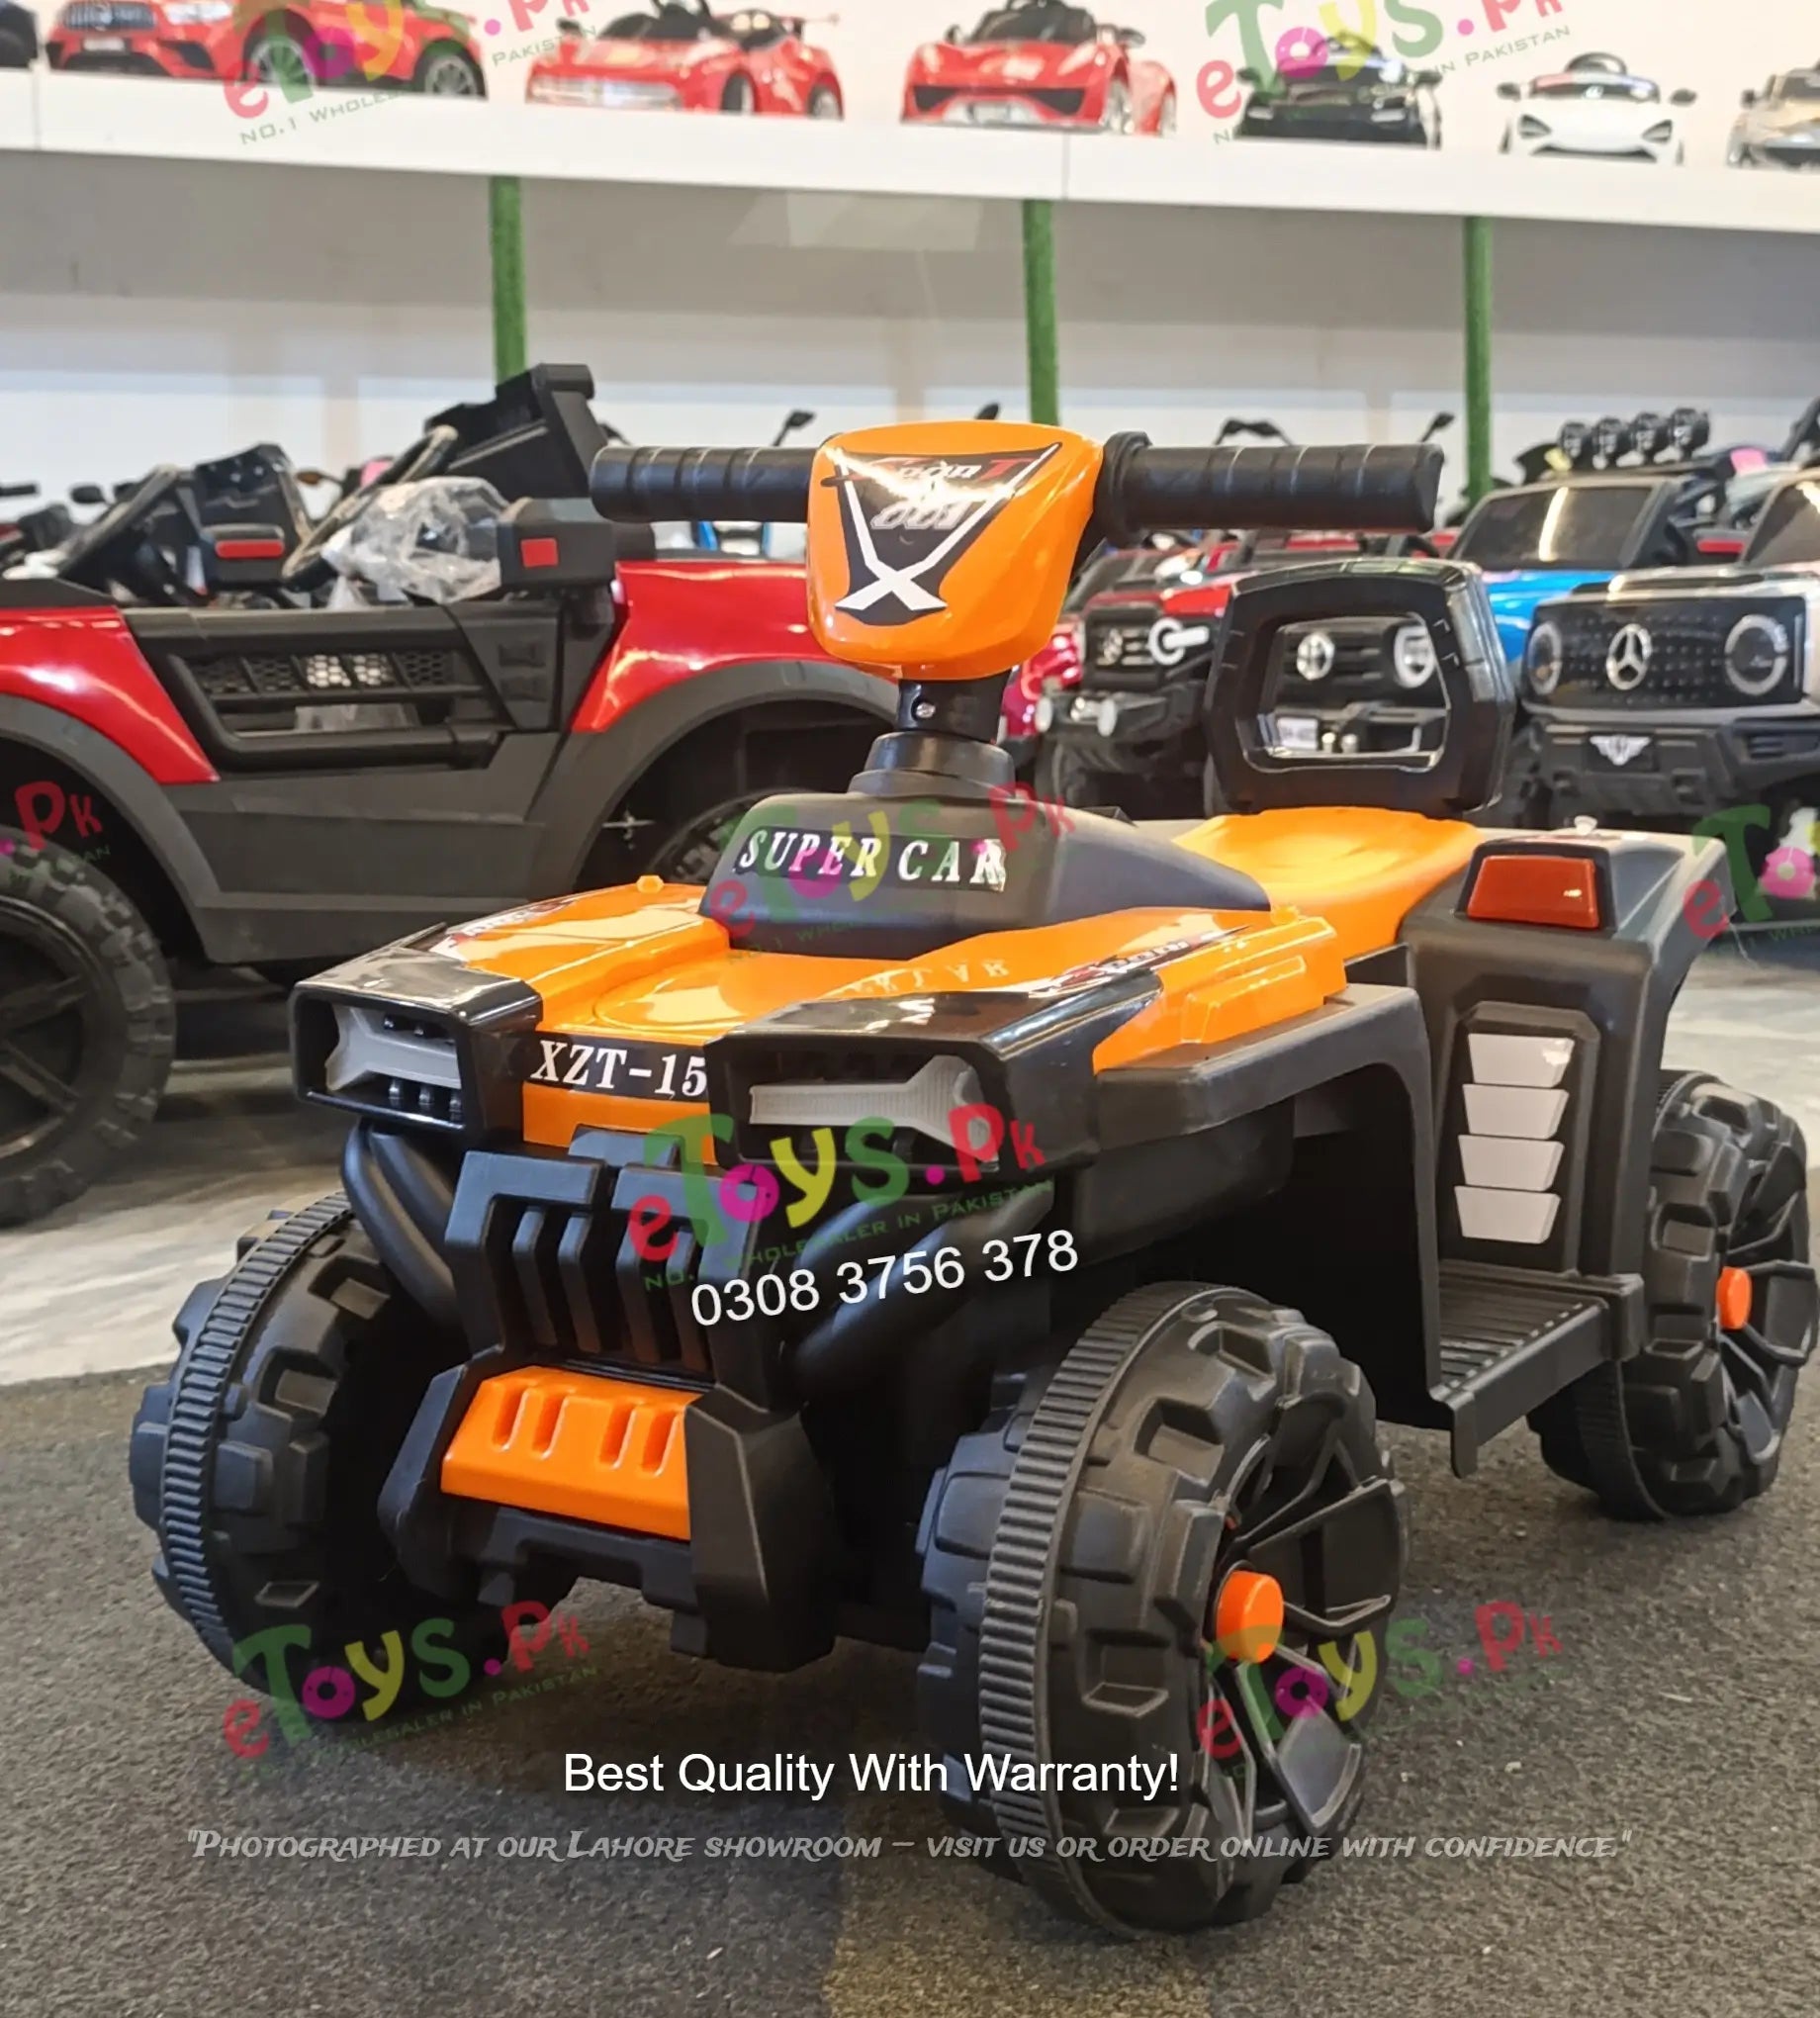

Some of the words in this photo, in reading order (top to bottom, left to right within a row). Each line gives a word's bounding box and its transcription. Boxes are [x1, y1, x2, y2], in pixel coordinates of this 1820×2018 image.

[739, 831, 881, 877] SUPER
[897, 838, 1003, 885] CAR
[530, 1040, 707, 1100] XZT-15
